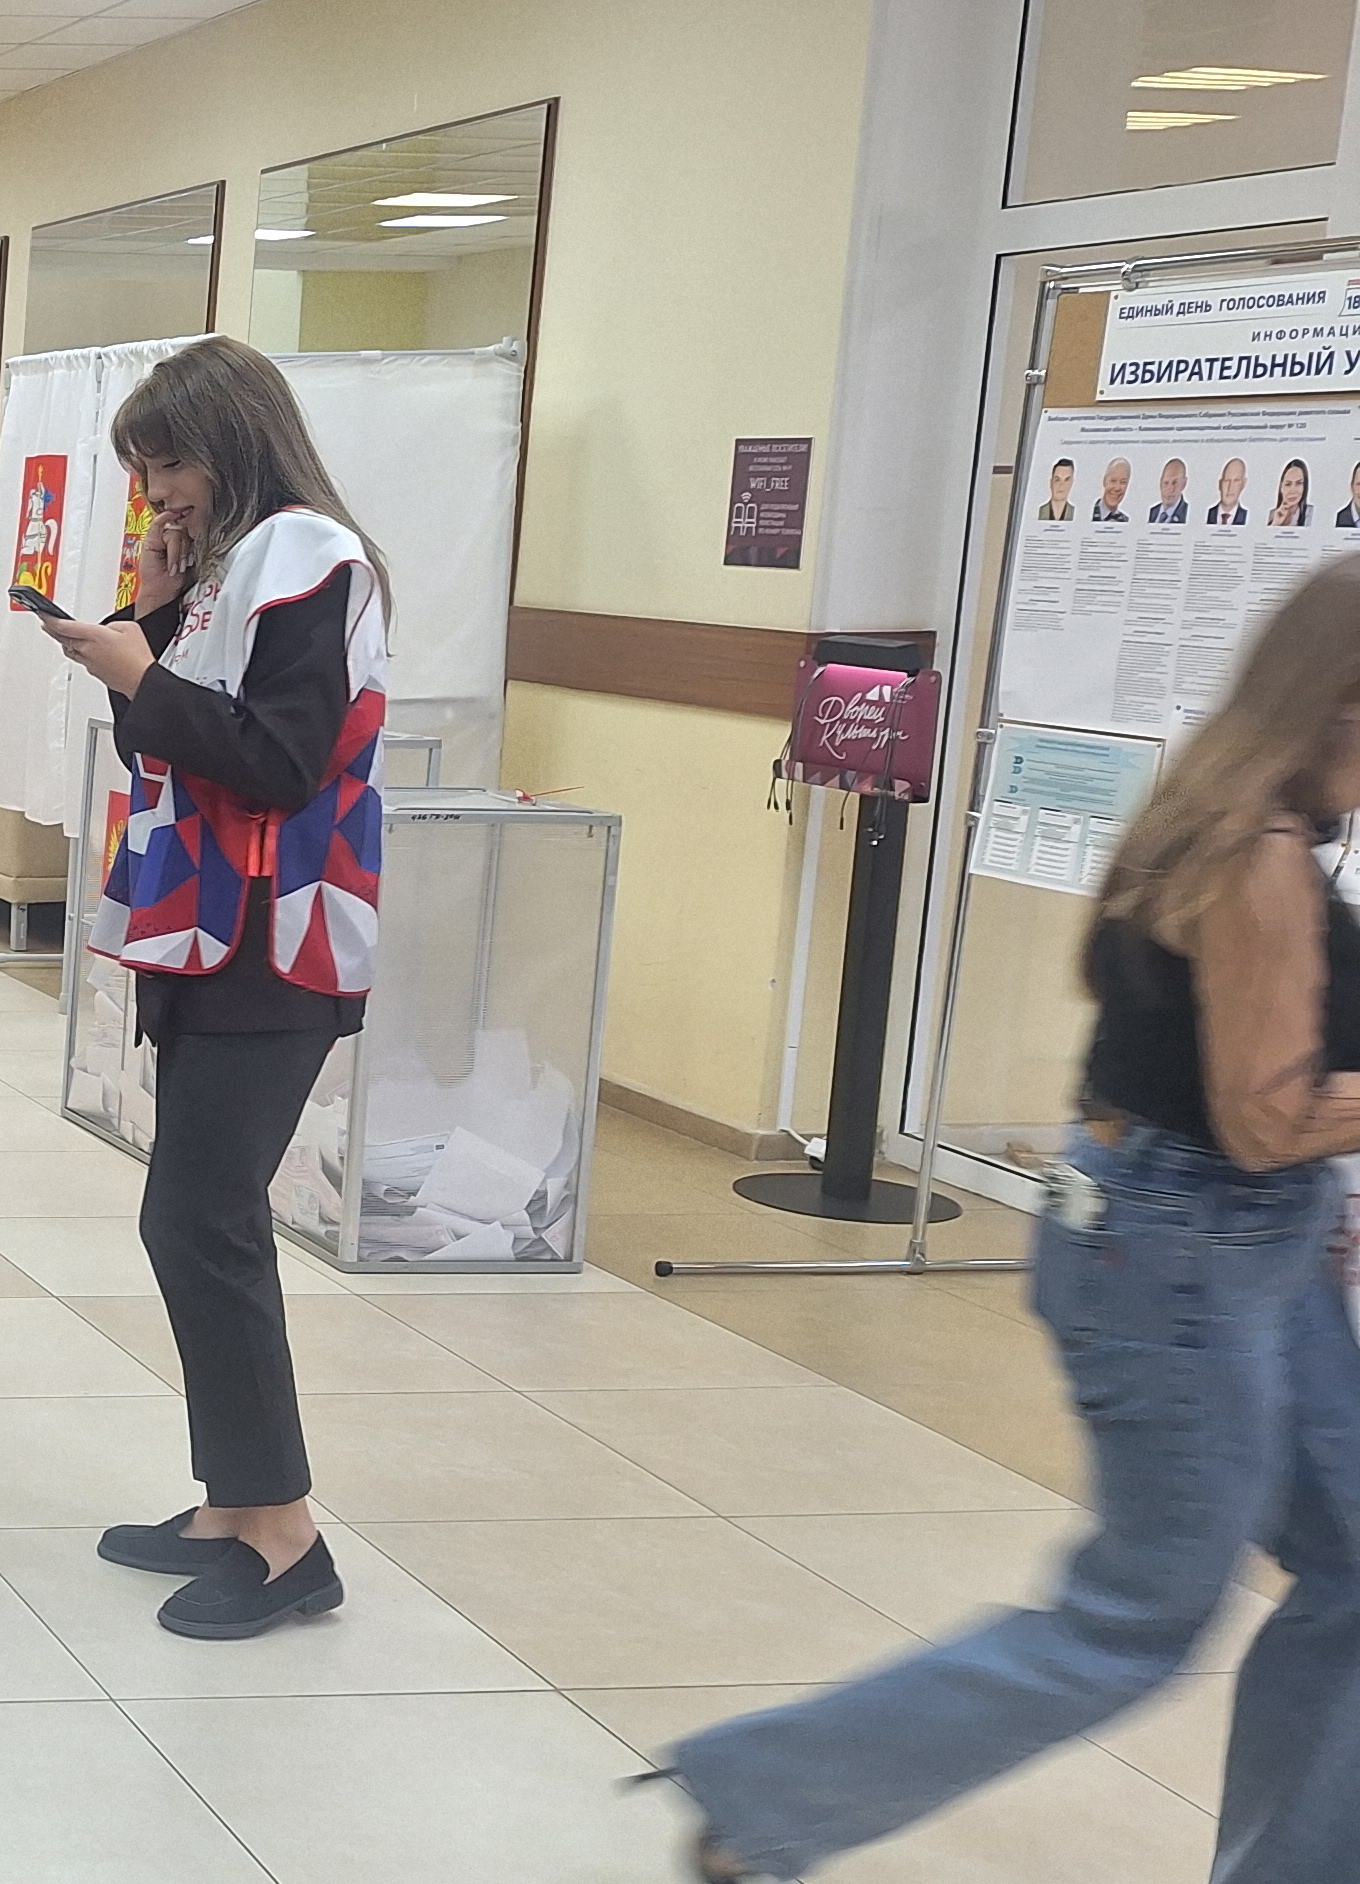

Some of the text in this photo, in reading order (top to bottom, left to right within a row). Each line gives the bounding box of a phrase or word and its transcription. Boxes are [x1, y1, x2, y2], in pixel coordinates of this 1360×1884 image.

[1118, 290, 1327, 320] ЕДИНЫЙ ДЕНЬ ГОЛОСОВАНИЯ
[1108, 345, 1336, 386] ИЗБИРАТЕЛЬНЫЙ
[813, 692, 886, 724] Дворец
